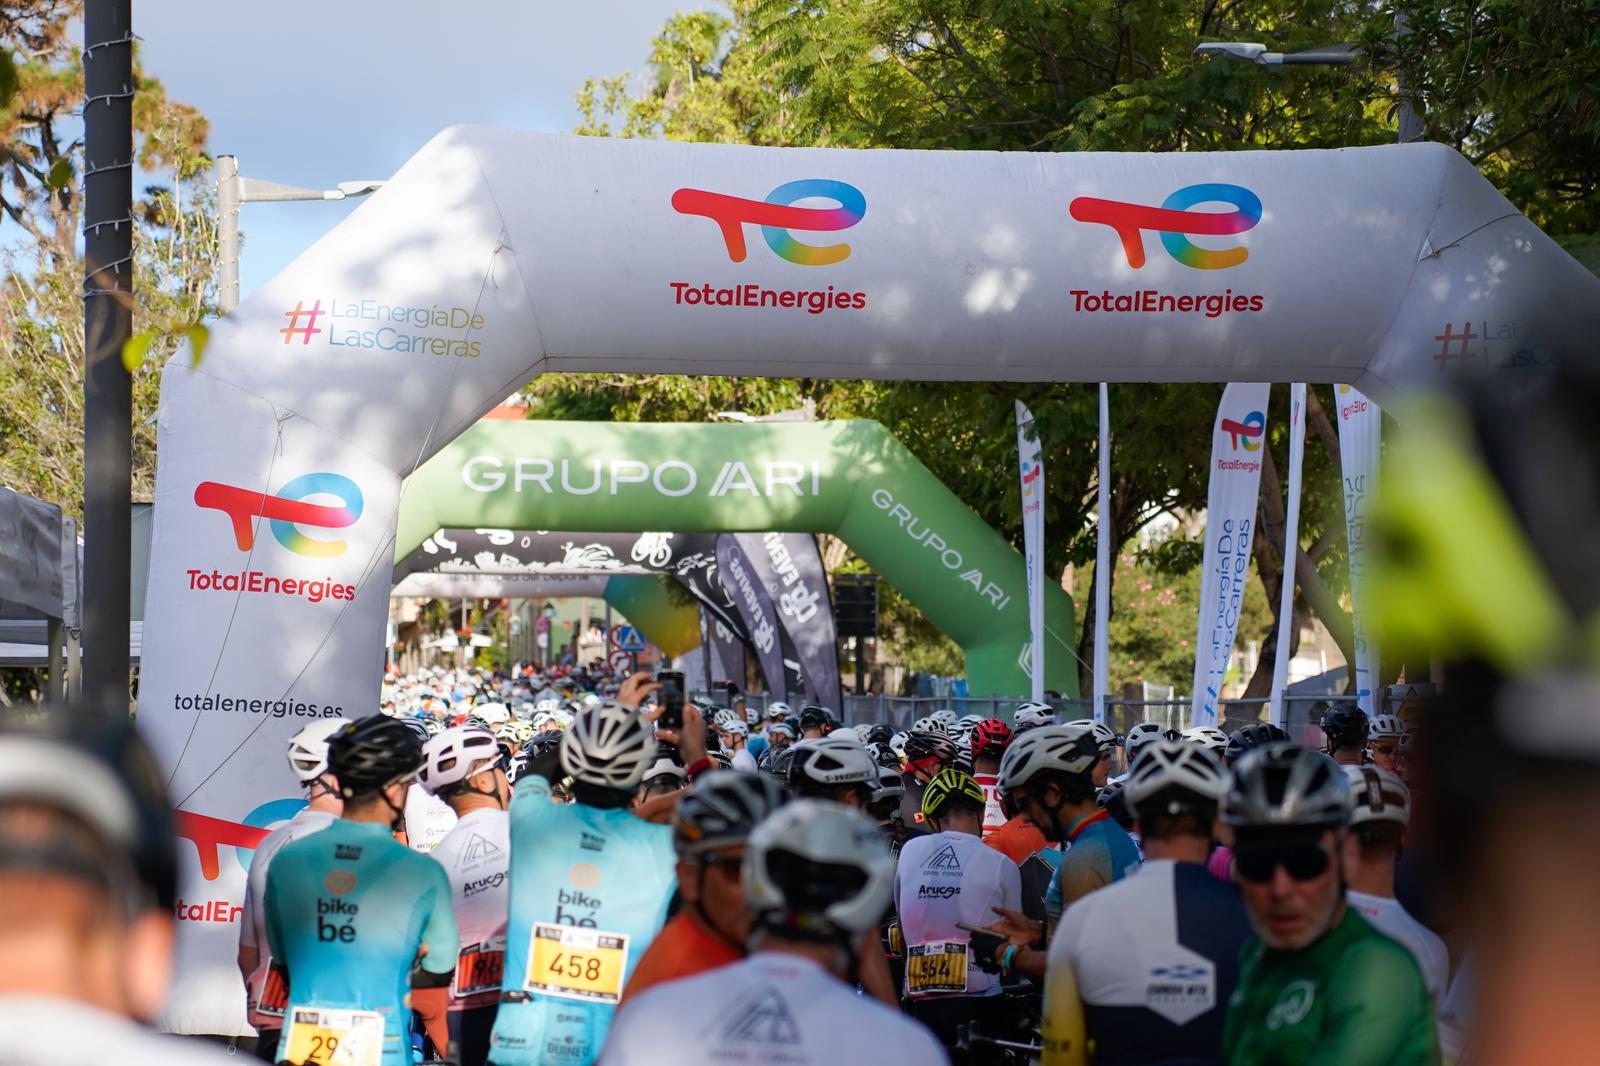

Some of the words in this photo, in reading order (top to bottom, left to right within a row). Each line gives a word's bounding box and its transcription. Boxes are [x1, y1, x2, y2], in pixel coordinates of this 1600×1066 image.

[670, 282, 866, 314] TotalEnergies
[1070, 289, 1264, 318] TotalEnergies
[329, 323, 482, 358] LasCarreras
[462, 455, 698, 497] GRUPO
[708, 461, 820, 497] ARI
[872, 489, 963, 570] GRUPO
[959, 569, 1011, 611] ARI
[187, 570, 356, 603] TotalEnergies
[174, 693, 343, 719] totalenergies.es
[317, 897, 359, 915] bike
[558, 888, 602, 909] bike
[317, 916, 357, 943] bé
[549, 952, 602, 981] 458
